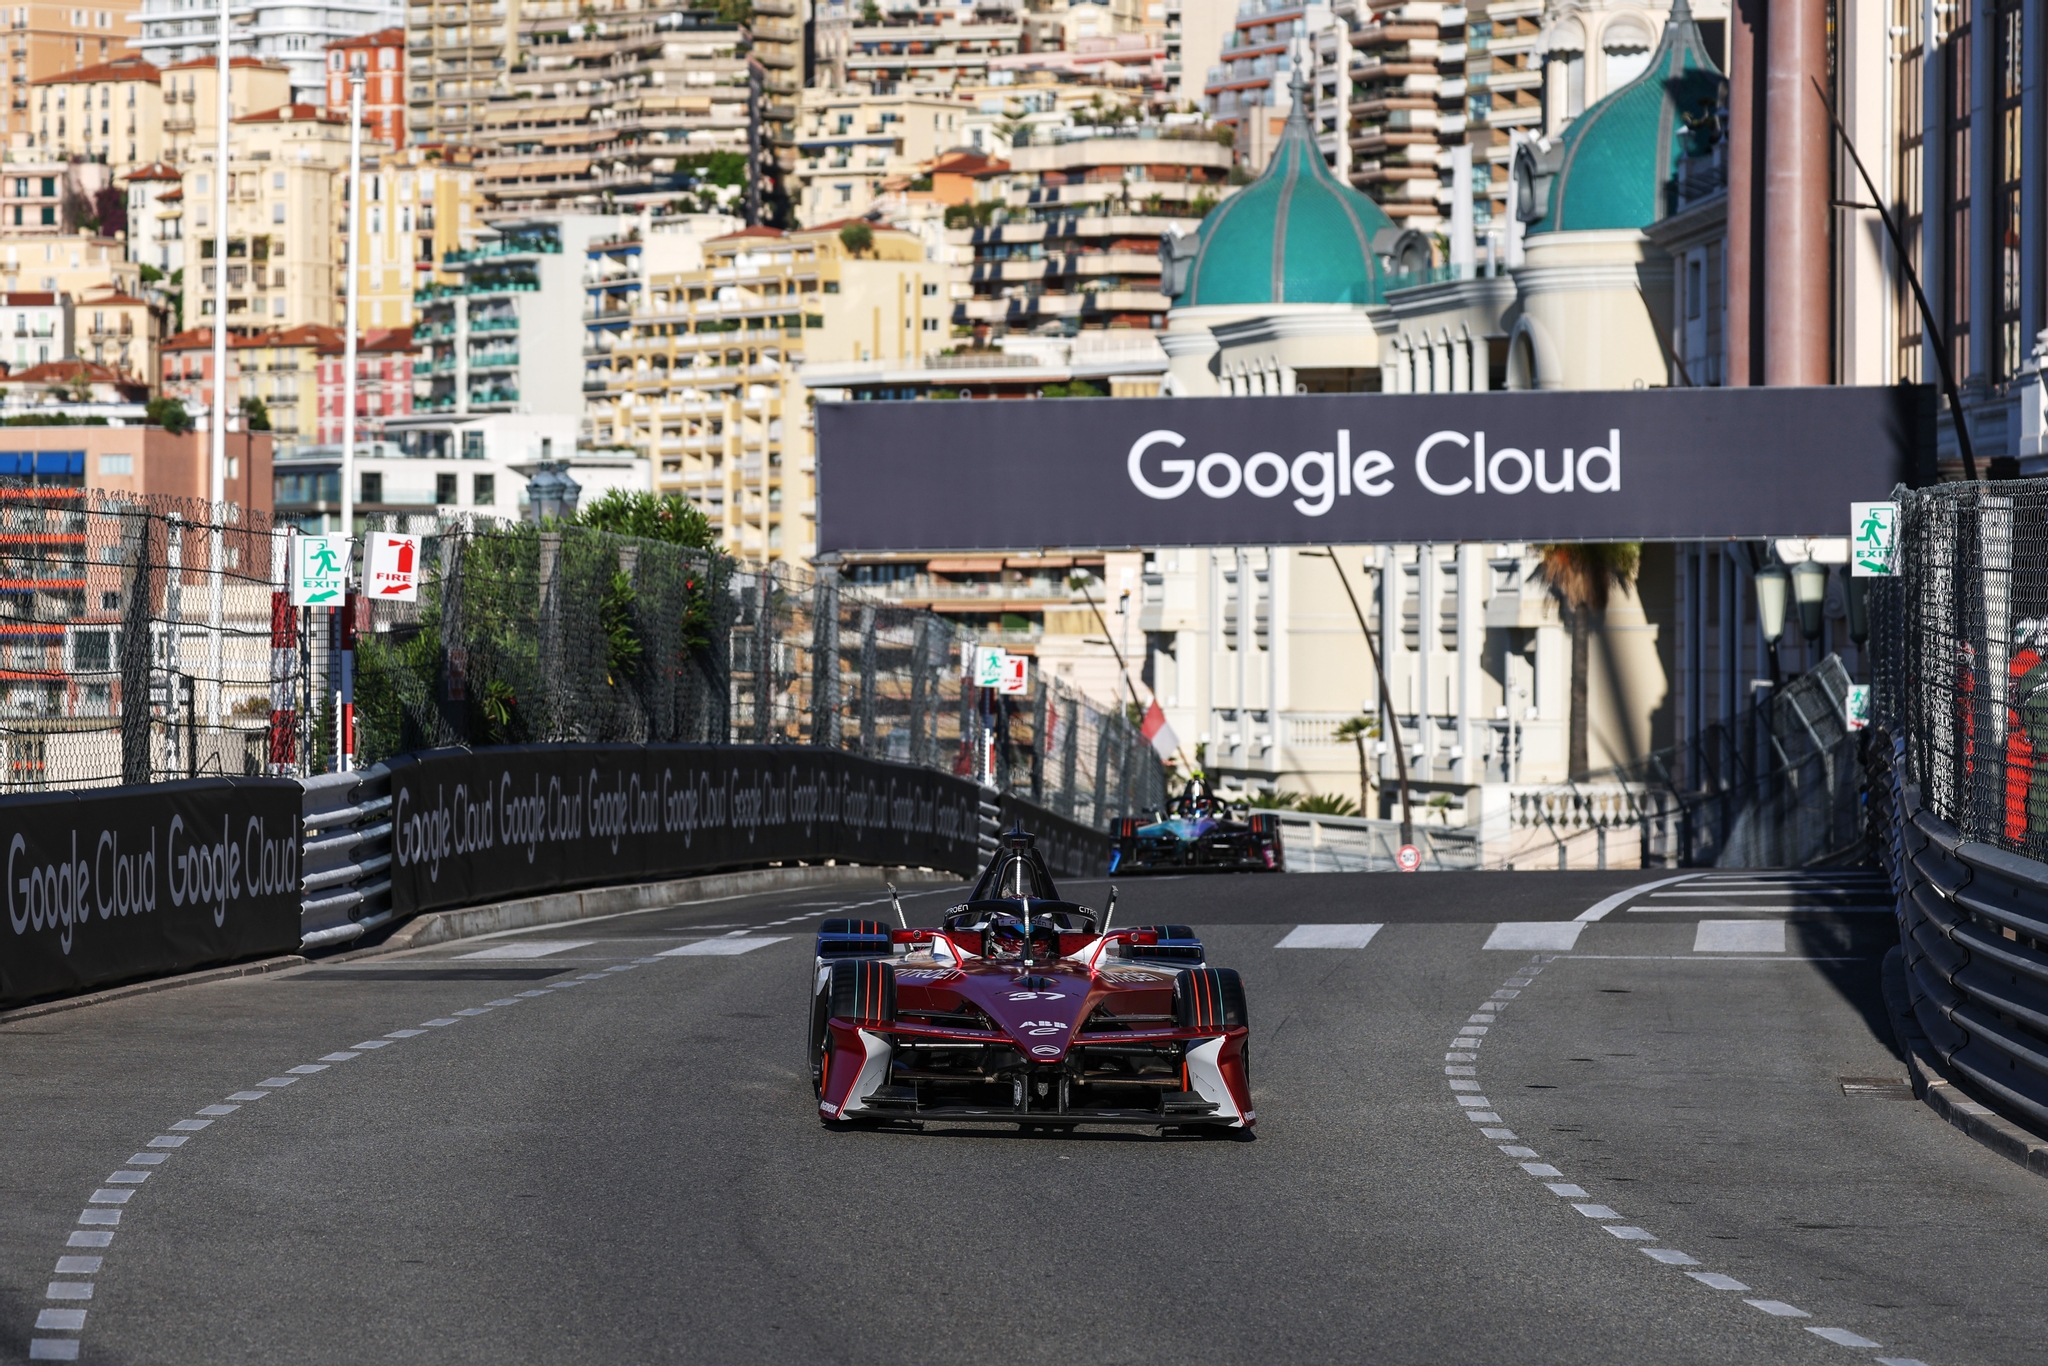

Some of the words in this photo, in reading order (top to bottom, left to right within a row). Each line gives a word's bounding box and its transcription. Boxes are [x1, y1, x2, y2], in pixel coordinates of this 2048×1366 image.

[1127, 429, 1395, 517] Google
[1415, 428, 1621, 496] Cloud
[1856, 550, 1892, 558] EXIT
[376, 572, 412, 582] FIRE
[303, 580, 340, 588] EXIT
[396, 784, 450, 883] Google
[454, 780, 493, 853] Cloud
[501, 771, 545, 864] Google
[549, 775, 582, 842] Cloud
[588, 768, 627, 855] Google
[629, 772, 659, 834] Cloud
[663, 768, 698, 849] Google
[701, 770, 726, 829] Cloud
[730, 768, 761, 844] Google
[8, 830, 89, 955] Google
[96, 827, 156, 920] Cloud
[168, 814, 240, 927] Google
[245, 814, 297, 898] Cloud
[1009, 991, 1066, 1001] 37
[1019, 1021, 1068, 1029] ABB
